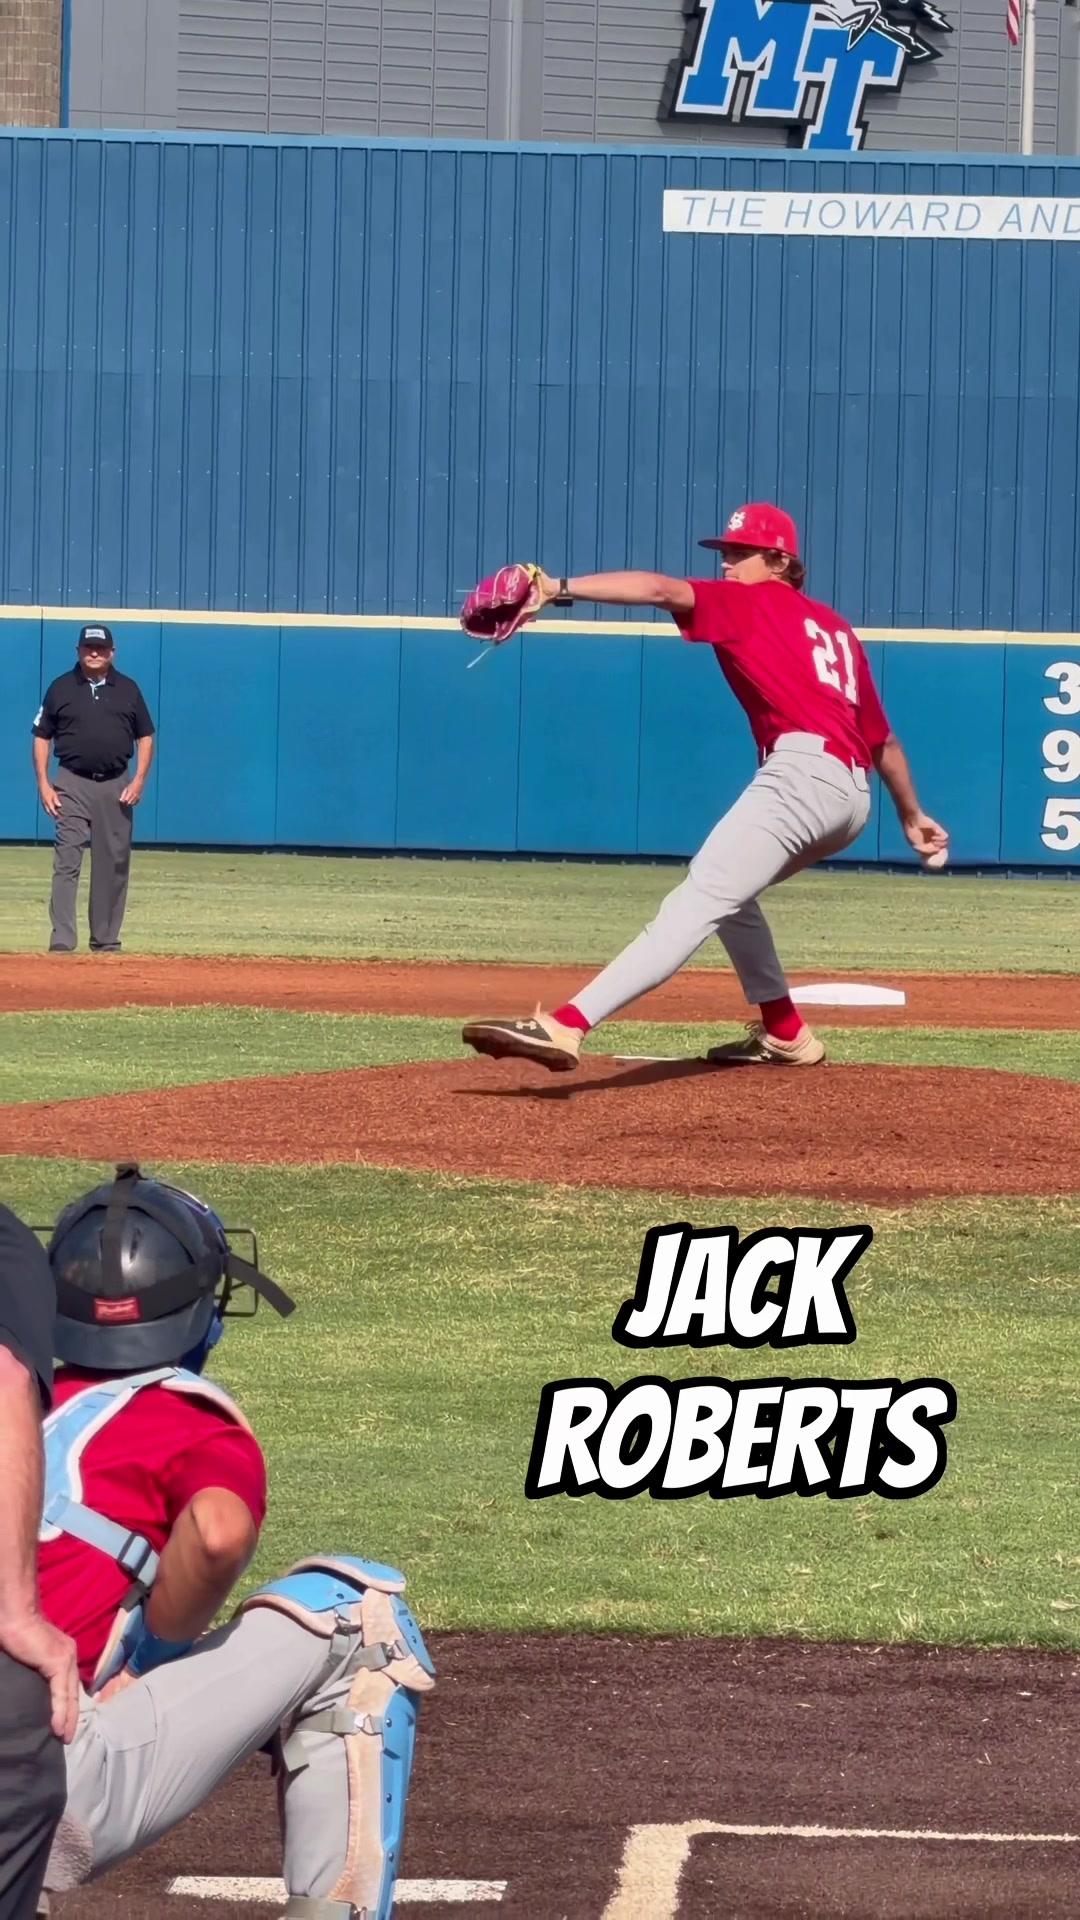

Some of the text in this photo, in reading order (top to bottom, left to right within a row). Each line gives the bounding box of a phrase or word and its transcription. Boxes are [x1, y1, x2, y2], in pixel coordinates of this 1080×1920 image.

[675, 0, 906, 150] MT
[683, 196, 1080, 234] THE HOWARD AND
[803, 617, 860, 706] 21
